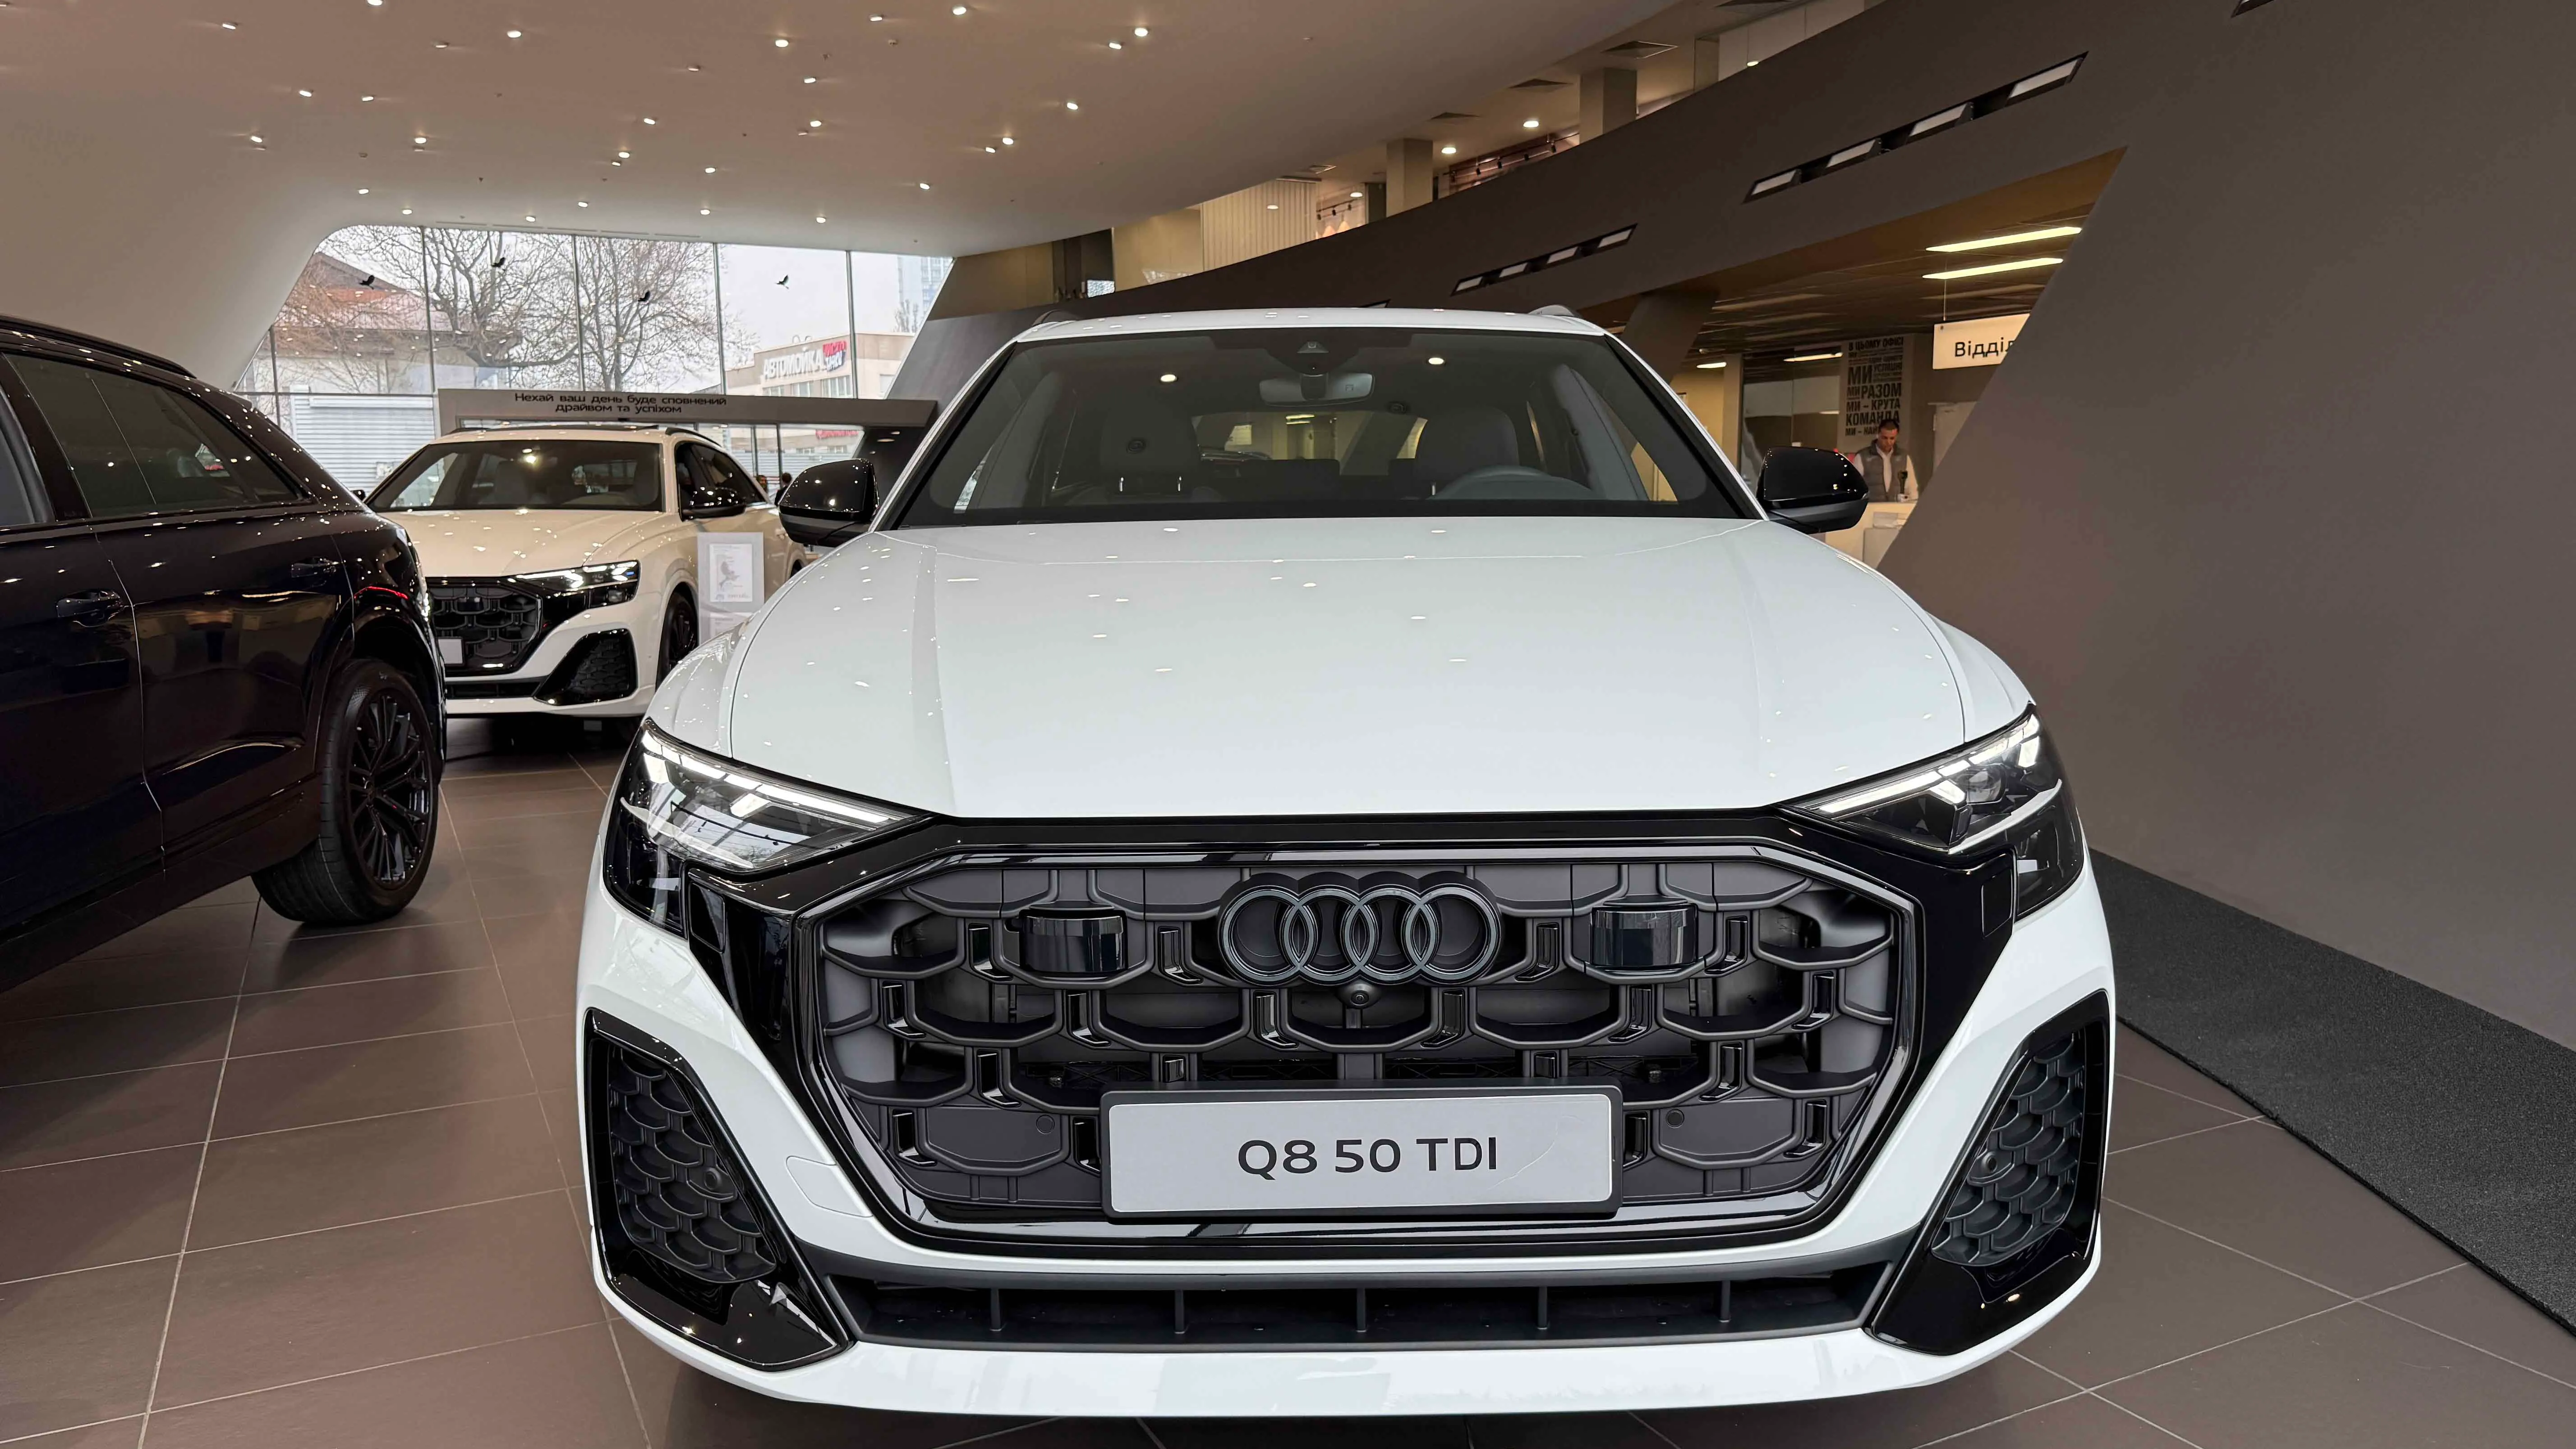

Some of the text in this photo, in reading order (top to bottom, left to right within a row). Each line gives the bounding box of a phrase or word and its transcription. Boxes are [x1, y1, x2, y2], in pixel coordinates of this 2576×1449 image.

[763, 346, 825, 379] АВТОМОЙКА
[1848, 365, 1872, 386] МИ
[515, 393, 554, 402] Нехай
[627, 395, 656, 405] буде
[662, 397, 727, 405] сповнений
[1861, 383, 1902, 399] РАЗОМ
[555, 404, 612, 413] драйвом
[635, 405, 681, 414] успіхом
[1846, 400, 1861, 413] МИ
[1871, 398, 1900, 410] КРУТА
[1238, 1136, 1497, 1181] Q8 50 TDI
